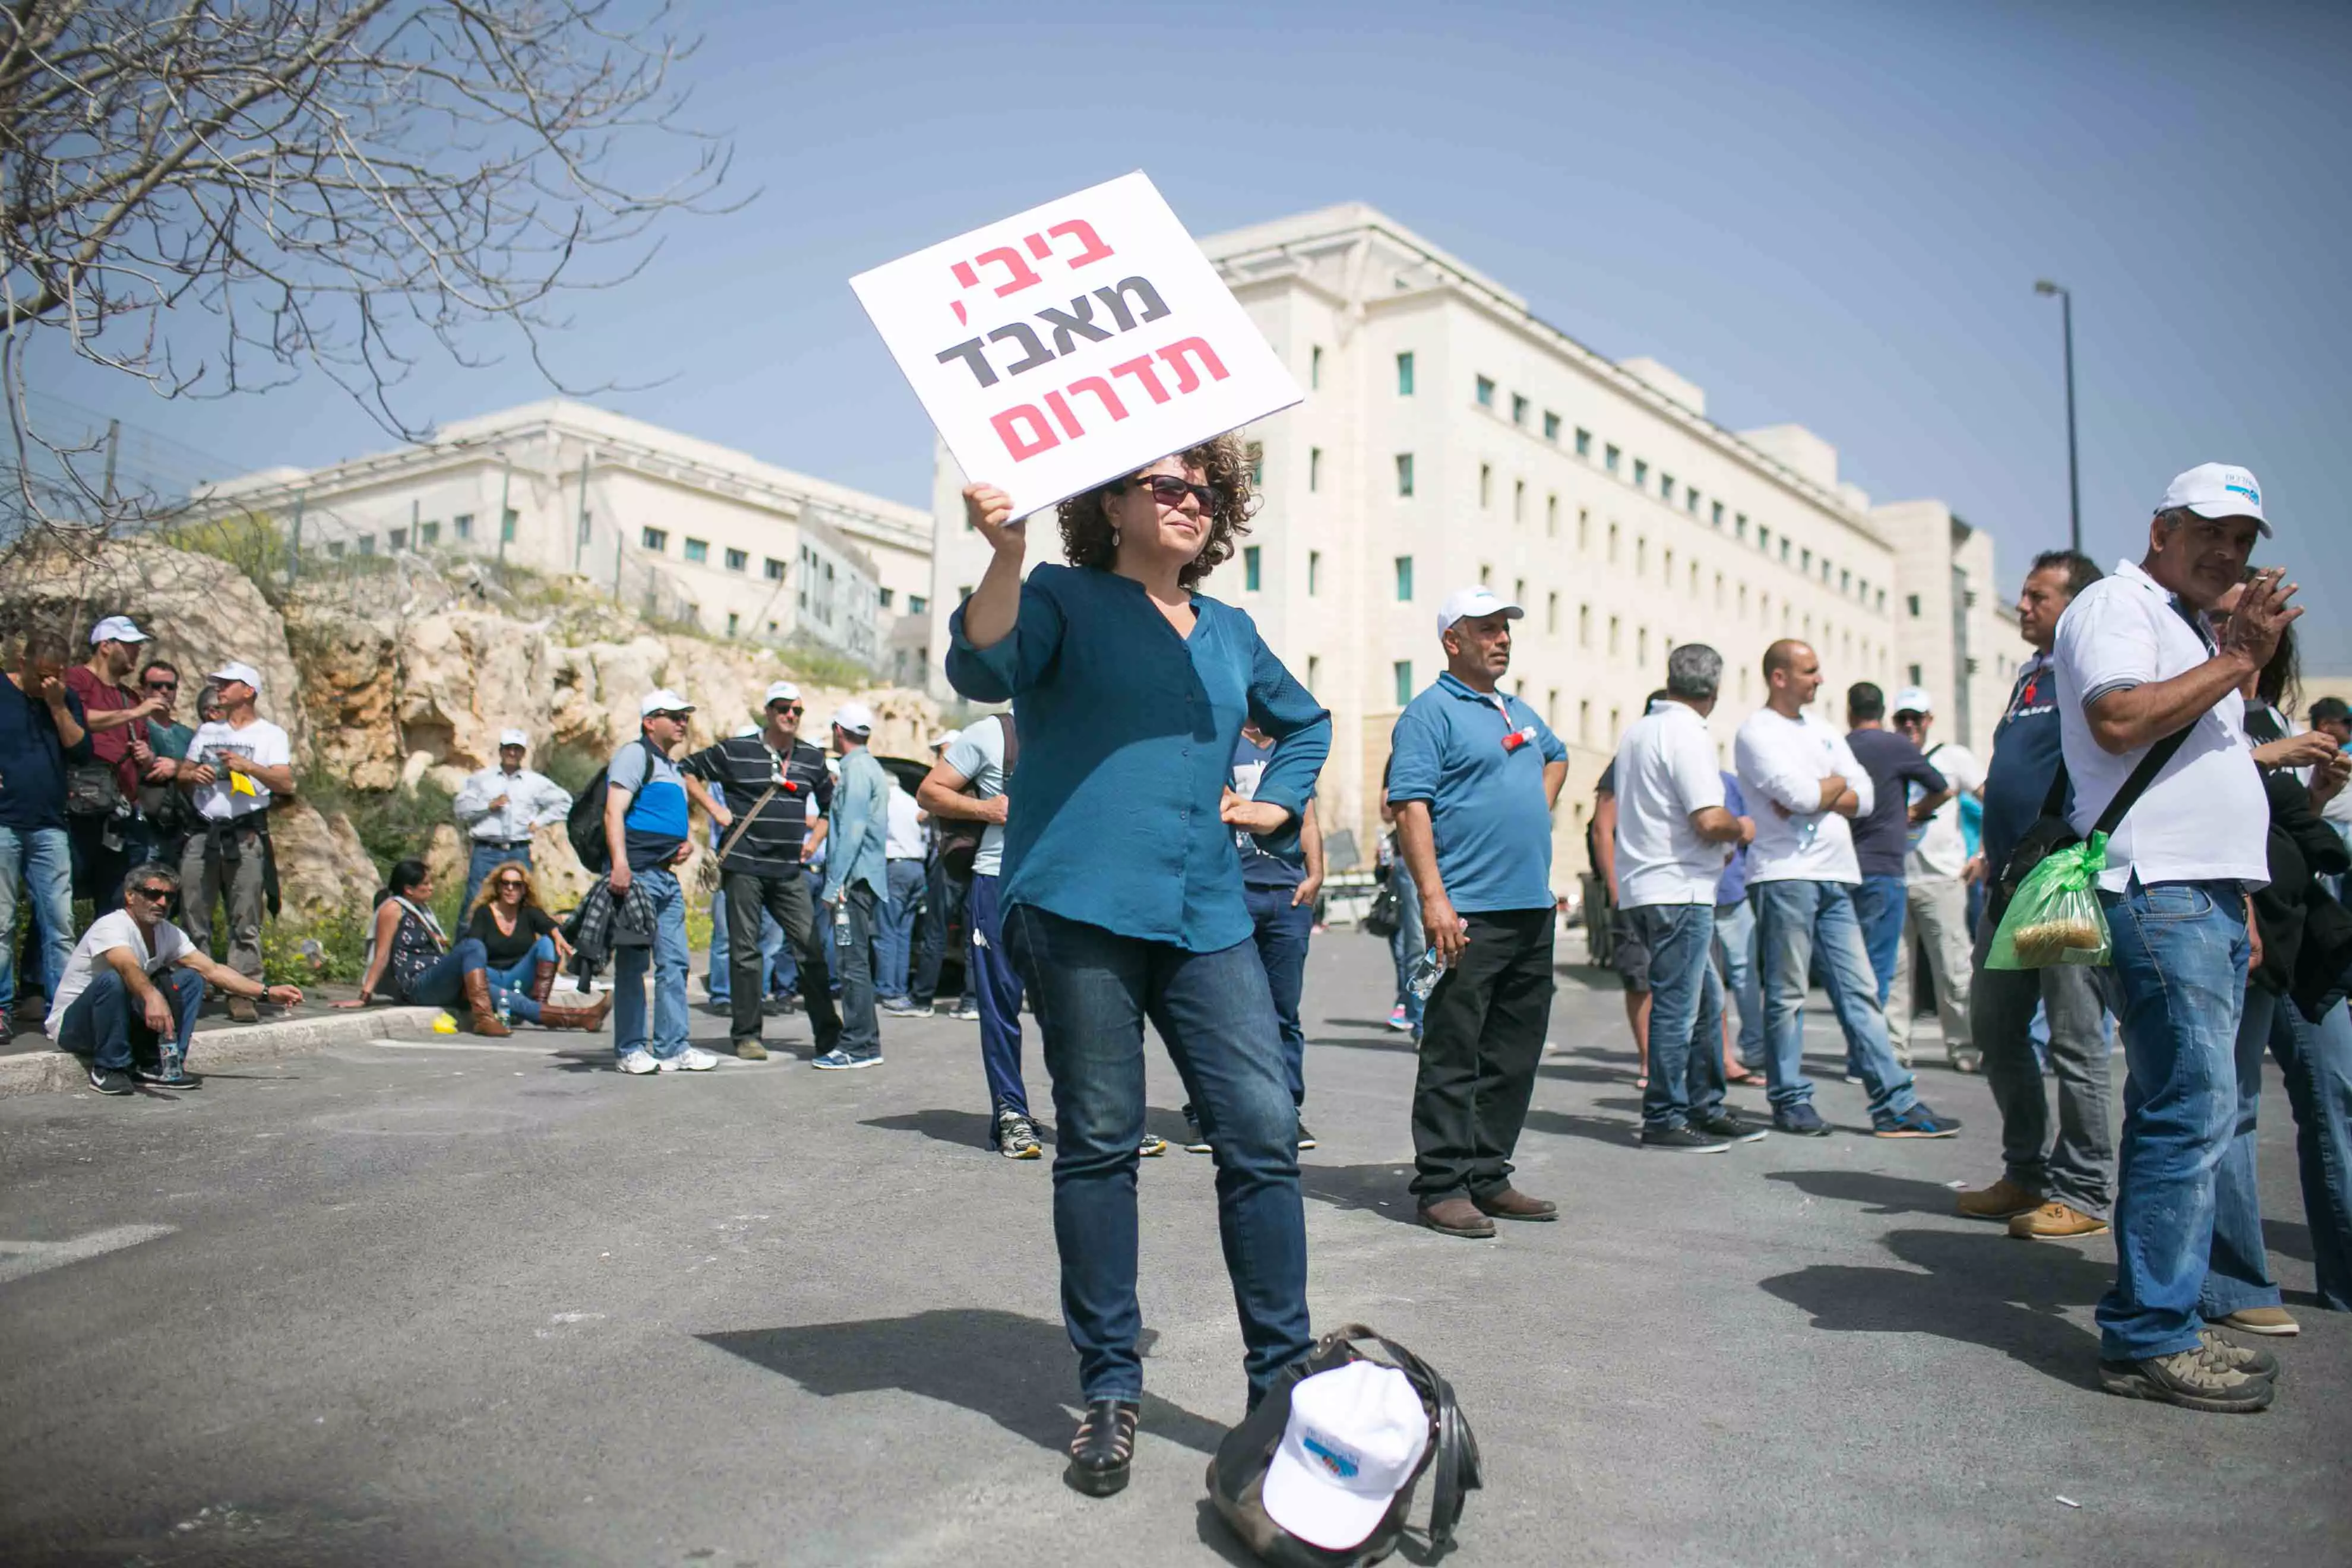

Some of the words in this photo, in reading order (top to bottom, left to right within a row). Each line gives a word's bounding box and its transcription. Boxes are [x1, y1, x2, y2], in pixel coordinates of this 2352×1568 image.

[950, 219, 1115, 327] ביבי,
[935, 276, 1172, 388] מאבד
[990, 336, 1231, 463] תדרום
